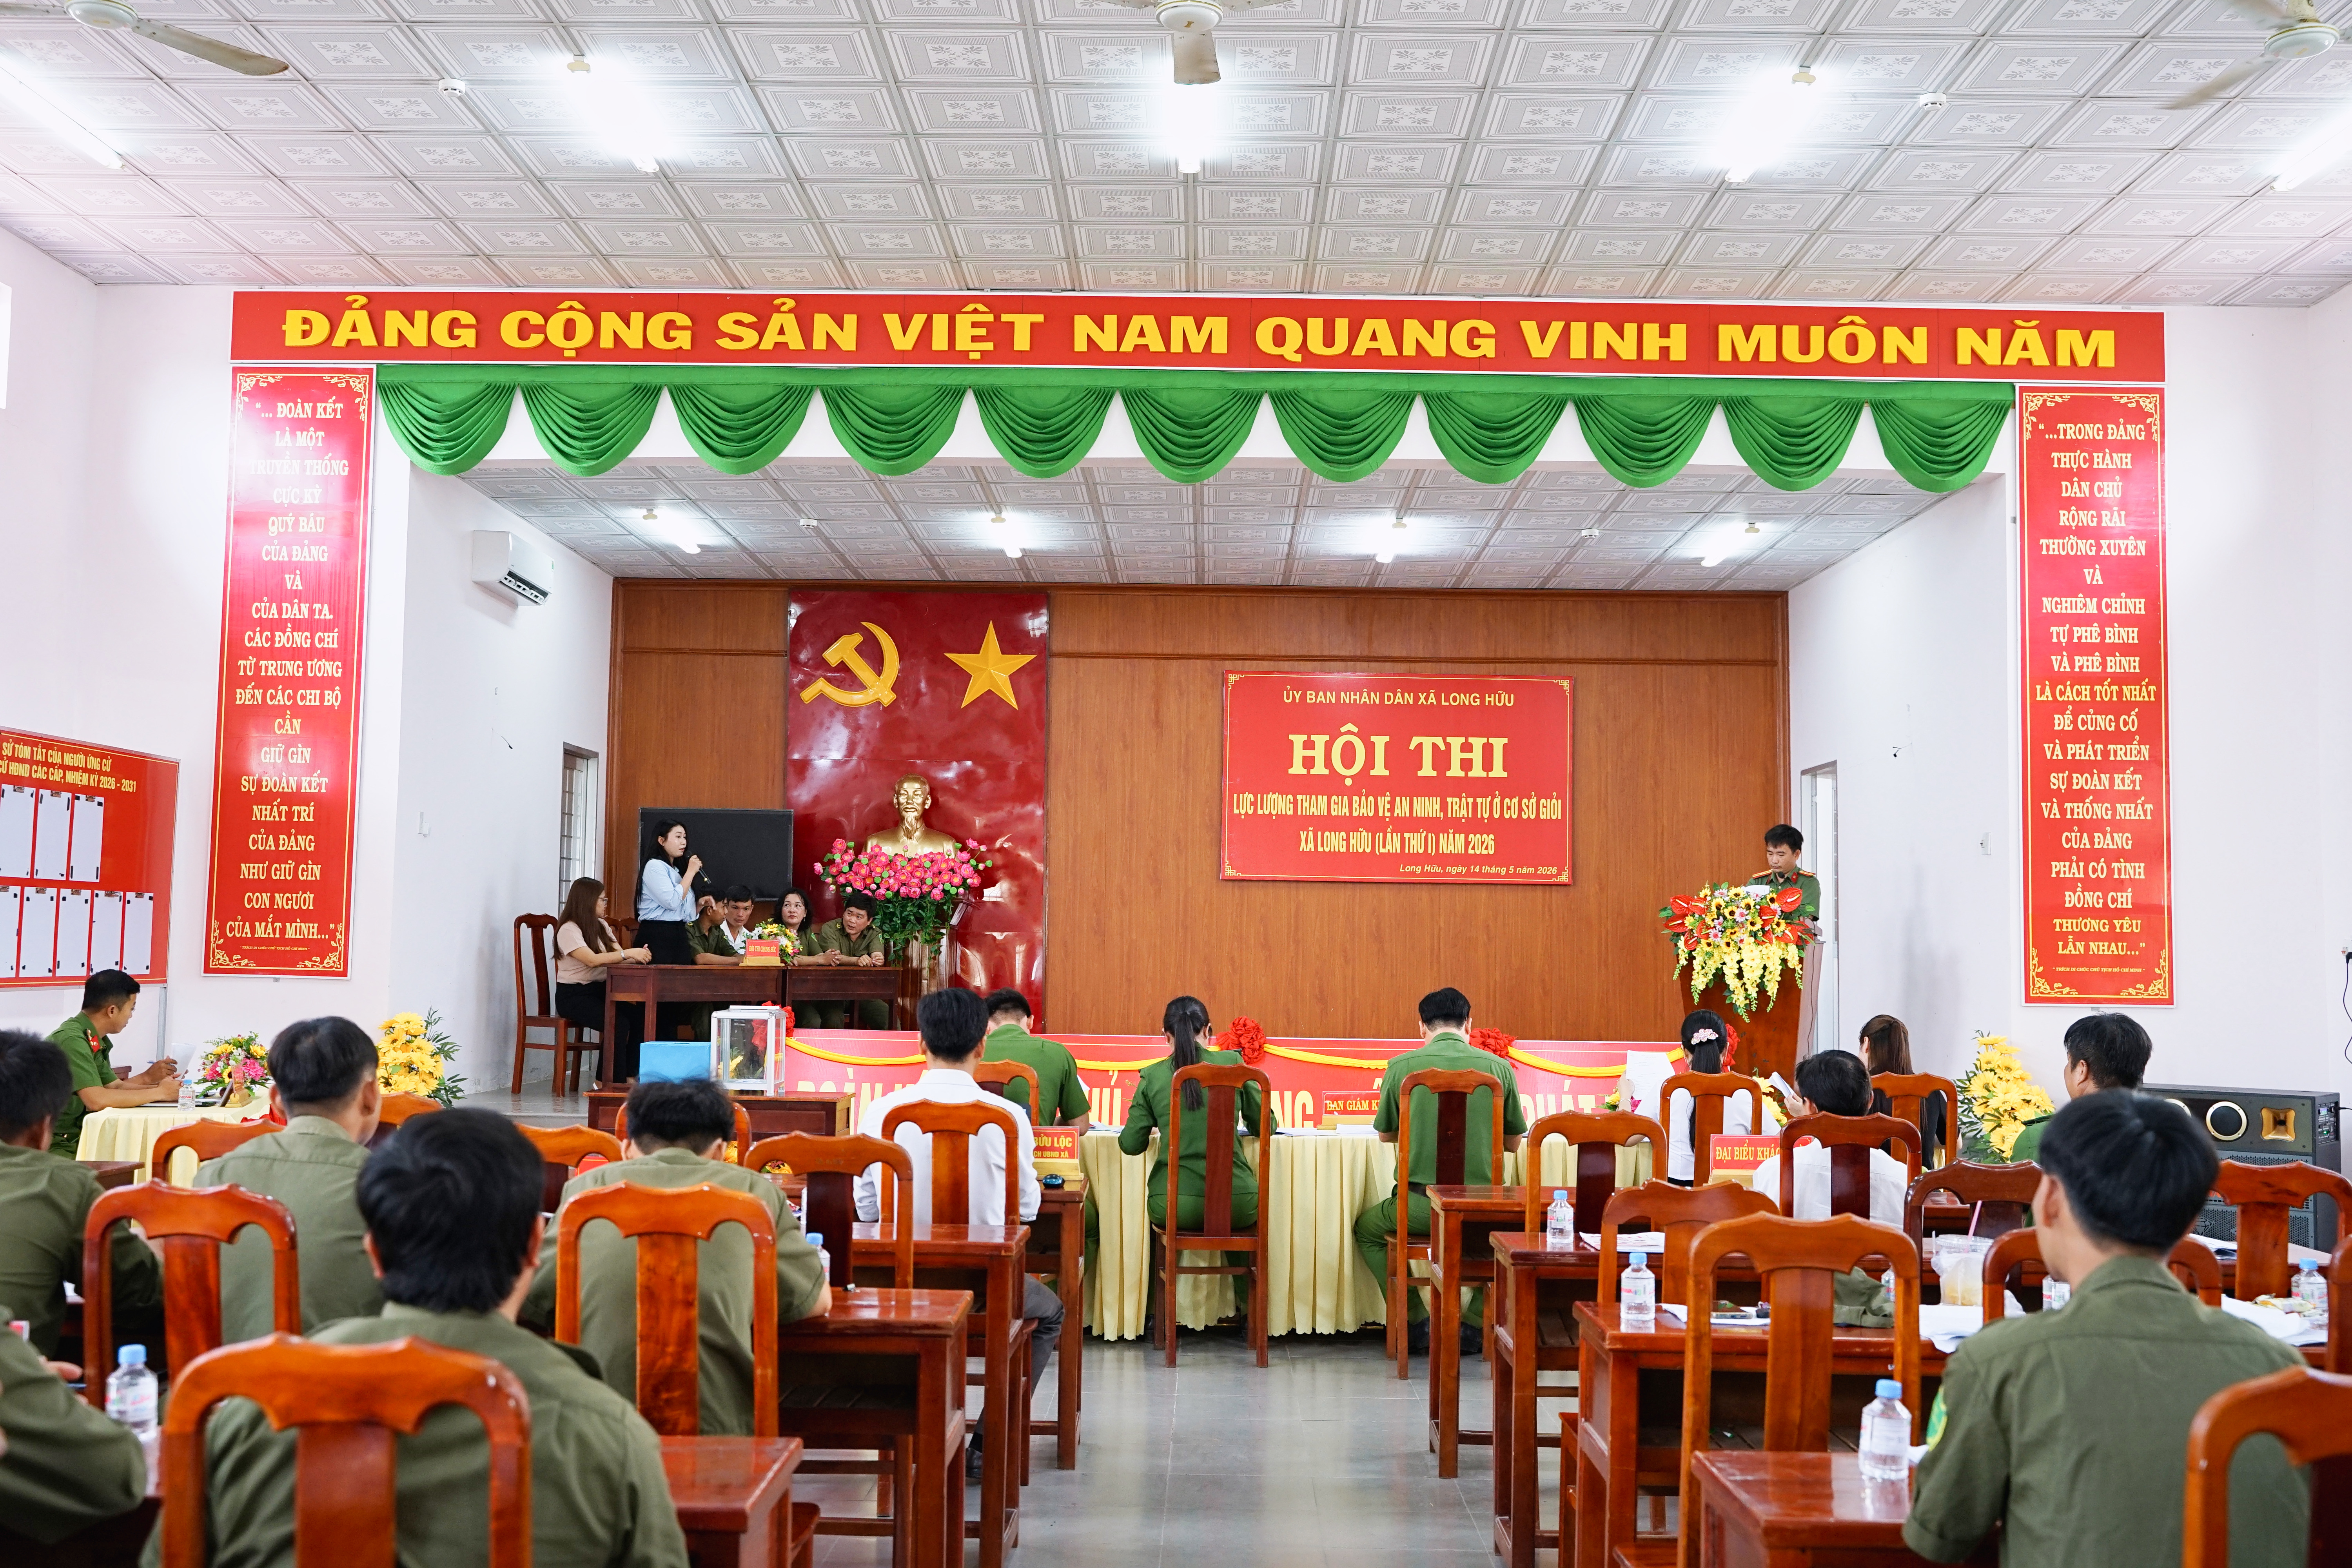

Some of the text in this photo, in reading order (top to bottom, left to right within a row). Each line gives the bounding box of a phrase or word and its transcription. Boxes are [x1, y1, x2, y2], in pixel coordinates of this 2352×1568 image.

[282, 295, 2114, 367] ĐẢNG CỘNG SẢN VIỆT NAM QUANG VINH MUÔN NĂM
[276, 399, 312, 418] ĐOÀN
[316, 396, 343, 418] KẾT
[275, 427, 325, 450] LÀ MỘT
[2107, 418, 2145, 440] ĐẢNG
[2051, 448, 2132, 472] THỰC HÀNH
[2062, 476, 2122, 498] DÂN CHỦ
[2059, 506, 2126, 529] RỘNG RÃI
[2040, 535, 2146, 555] THƯỜNG XUYÊN
[252, 597, 333, 619] CỦA DÂN TA.
[2042, 592, 2145, 614] NGHIÊM CHỈNH
[245, 623, 338, 648] CÁC ĐỒNG CHÍ
[2050, 623, 2138, 646] TỰ PHÊ BÌNH
[238, 656, 342, 677] TỪ TRUNG ƯƠNG
[236, 682, 341, 709] ĐẾN CÁC CHI BỘ
[1284, 686, 1514, 706] ỦY BAN NHÂN DÂN XÃ LONG HỮU
[2036, 678, 2156, 701] LÀ CÁCH TỐT NHẤT
[275, 710, 301, 734] CẦN
[2054, 705, 2138, 731] ĐỂ CỦNG CỐ
[2, 739, 112, 772] SỬ TÓM TẮT CỦA NGƯỜI ỨNG CỬ
[261, 744, 311, 763] GIỮ GÌN
[1289, 723, 1508, 786] HỘI THI
[2043, 735, 2149, 760] VÀ PHÁT TRIỂN
[9, 762, 30, 777] HĐND
[32, 764, 47, 779] CÁC
[49, 764, 64, 784] CẤP,
[65, 769, 89, 787] NHIỆM
[90, 772, 98, 787] KỲ
[100, 776, 115, 789] 2026
[121, 779, 136, 793] 2031
[241, 770, 328, 795] SỰ ĐOÀN KẾT
[252, 798, 314, 821] NHẤT TRÍ
[1234, 791, 1561, 822] LỰC LƯỢNG THAM GIA BẢO VỆ AN NINH, TRẬT TỰ Ở CƠ SỞ GIỎI
[249, 829, 315, 851] CỦA ĐẢNG
[1300, 826, 1494, 856] XÃ LONG HỮU (LẦN THỨ I) NĂM 2026
[240, 860, 321, 880] NHƯ GIỮ GÌN
[1400, 864, 1421, 873] Long
[1424, 864, 1443, 873] Hữu,
[1446, 865, 1467, 874] ngày
[1482, 866, 1506, 875] tháng
[2051, 856, 2145, 878] PHẢI CÓ TÌNH
[245, 891, 314, 909] CON NGƯƠI
[2065, 883, 2132, 908] ĐỒNG CHÍ
[227, 914, 334, 938] CỦA MẮT MÌNH...”
[2053, 916, 2141, 932] THƯƠNG YÊU
[2058, 935, 2085, 954] LẪN
[1327, 1100, 1344, 1111] BAN
[1346, 1098, 1369, 1111] GIÁM
[1054, 1135, 1073, 1149] LỘC
[1715, 1147, 1731, 1163] ĐẠI
[1733, 1139, 1754, 1160] BIỂU
